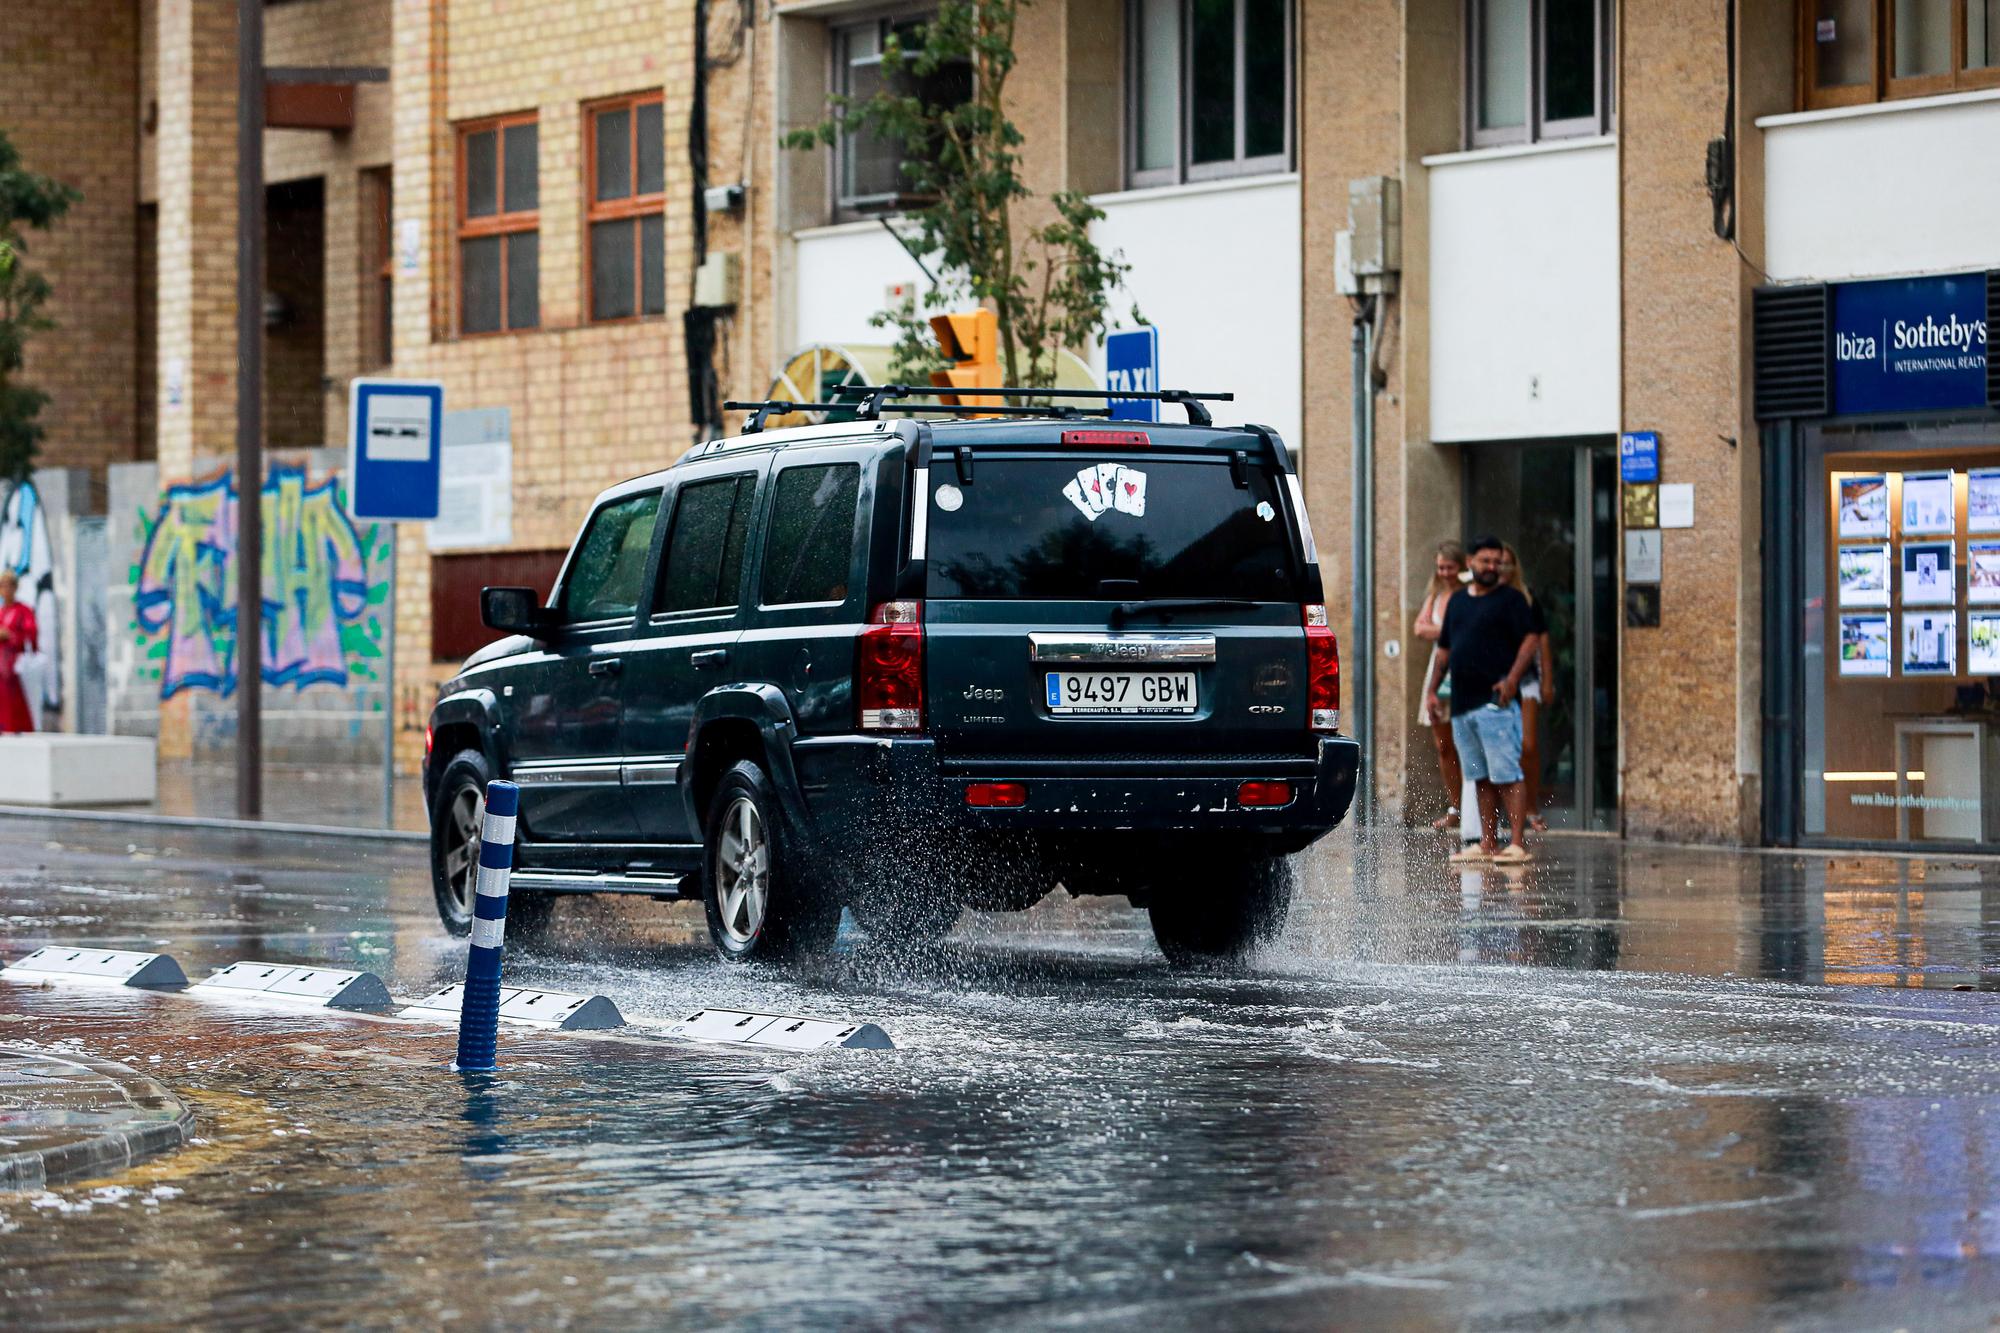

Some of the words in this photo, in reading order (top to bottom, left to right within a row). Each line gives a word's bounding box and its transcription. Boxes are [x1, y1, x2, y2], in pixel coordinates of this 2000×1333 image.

[1893, 313, 1987, 353] Sotheby's
[1836, 331, 1876, 361] Ibiza
[1894, 357, 1957, 373] INTERNATIONAL
[1107, 367, 1152, 404] TAXI
[1108, 642, 1148, 660] Jeep
[963, 684, 1005, 704] Jeep
[1051, 693, 1057, 701] E
[1066, 676, 1131, 703] 9497
[1141, 676, 1189, 703] GBW
[1248, 705, 1285, 714] CRD
[963, 715, 1006, 724] LIMITED
